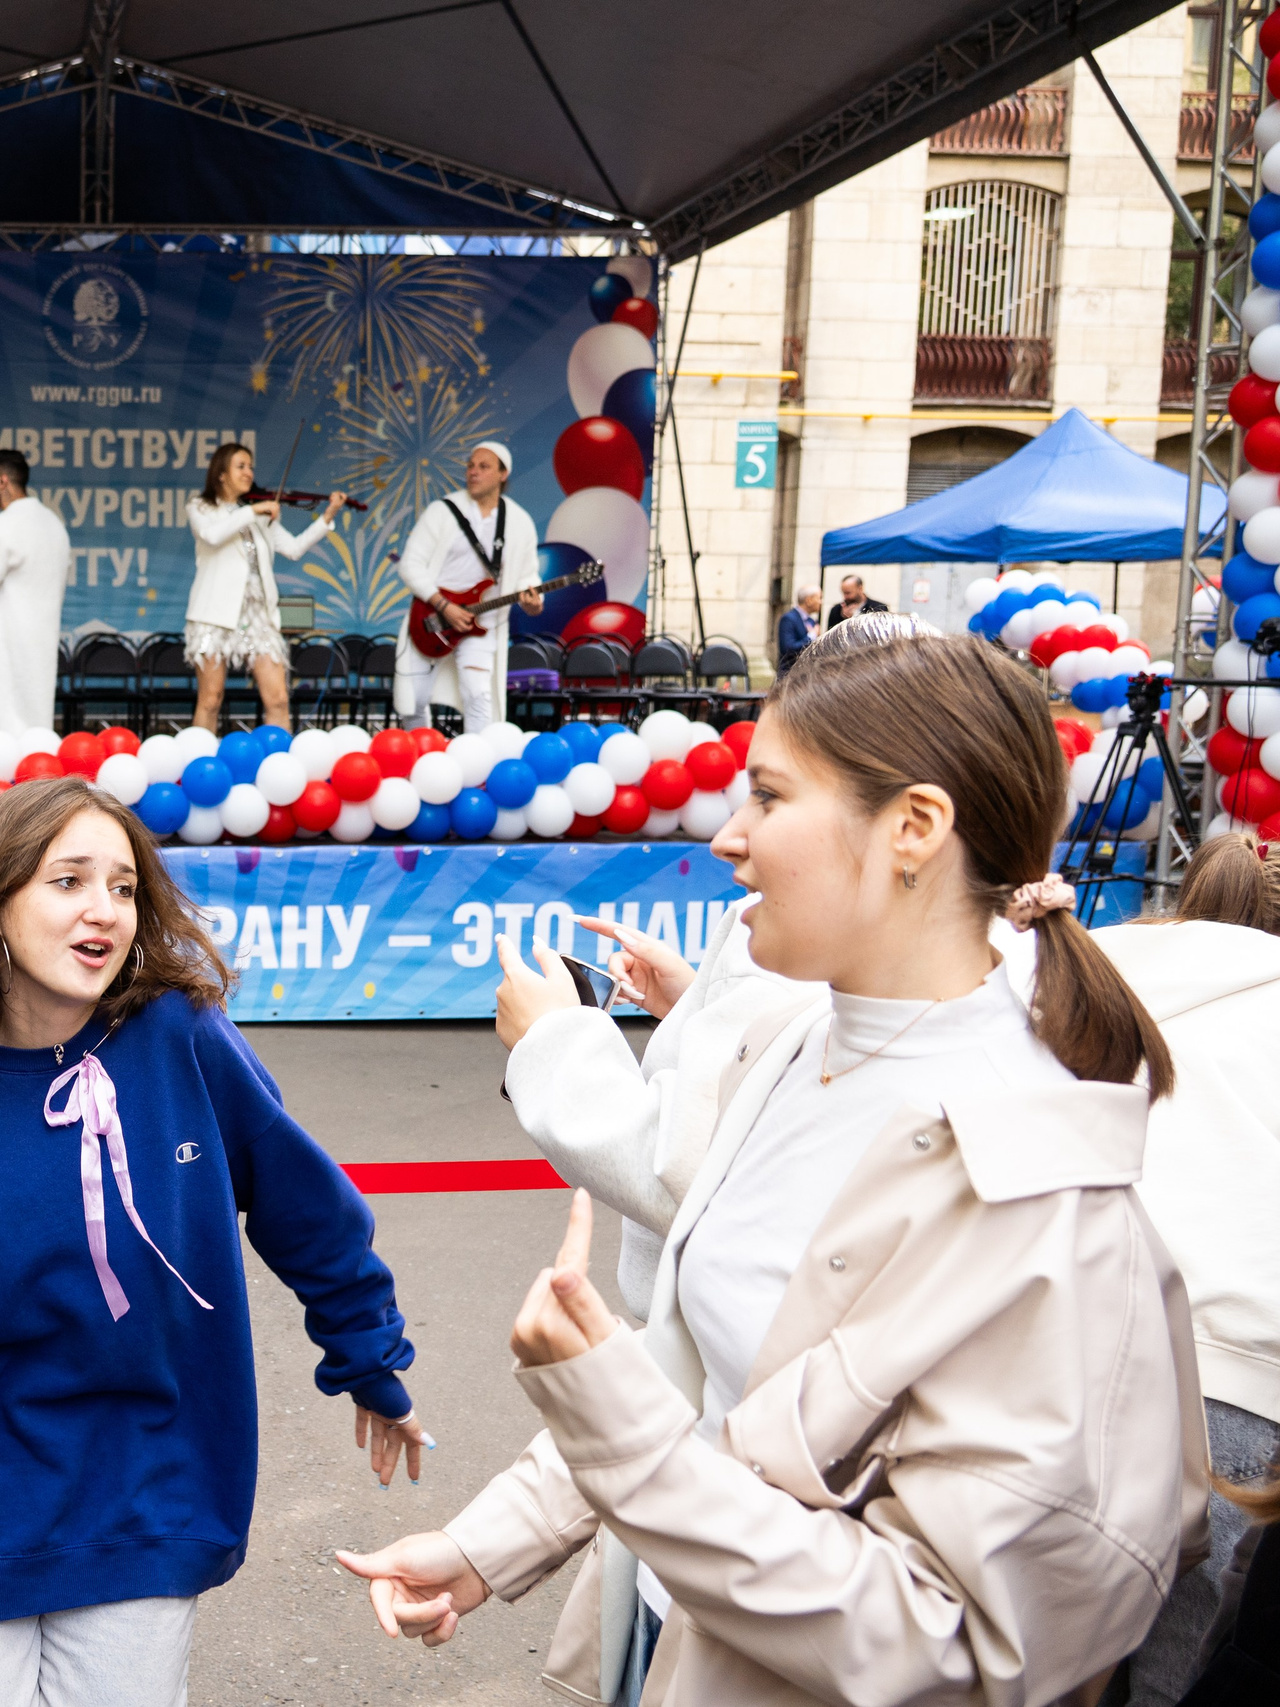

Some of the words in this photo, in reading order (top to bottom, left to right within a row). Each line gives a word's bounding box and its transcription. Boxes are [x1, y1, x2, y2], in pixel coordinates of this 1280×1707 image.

[31, 385, 162, 407] www.rggu.ru
[742, 443, 767, 484] 5
[67, 547, 148, 587] ГГУ!
[182, 904, 371, 970] РАНУ
[451, 901, 575, 968] ЭТО
